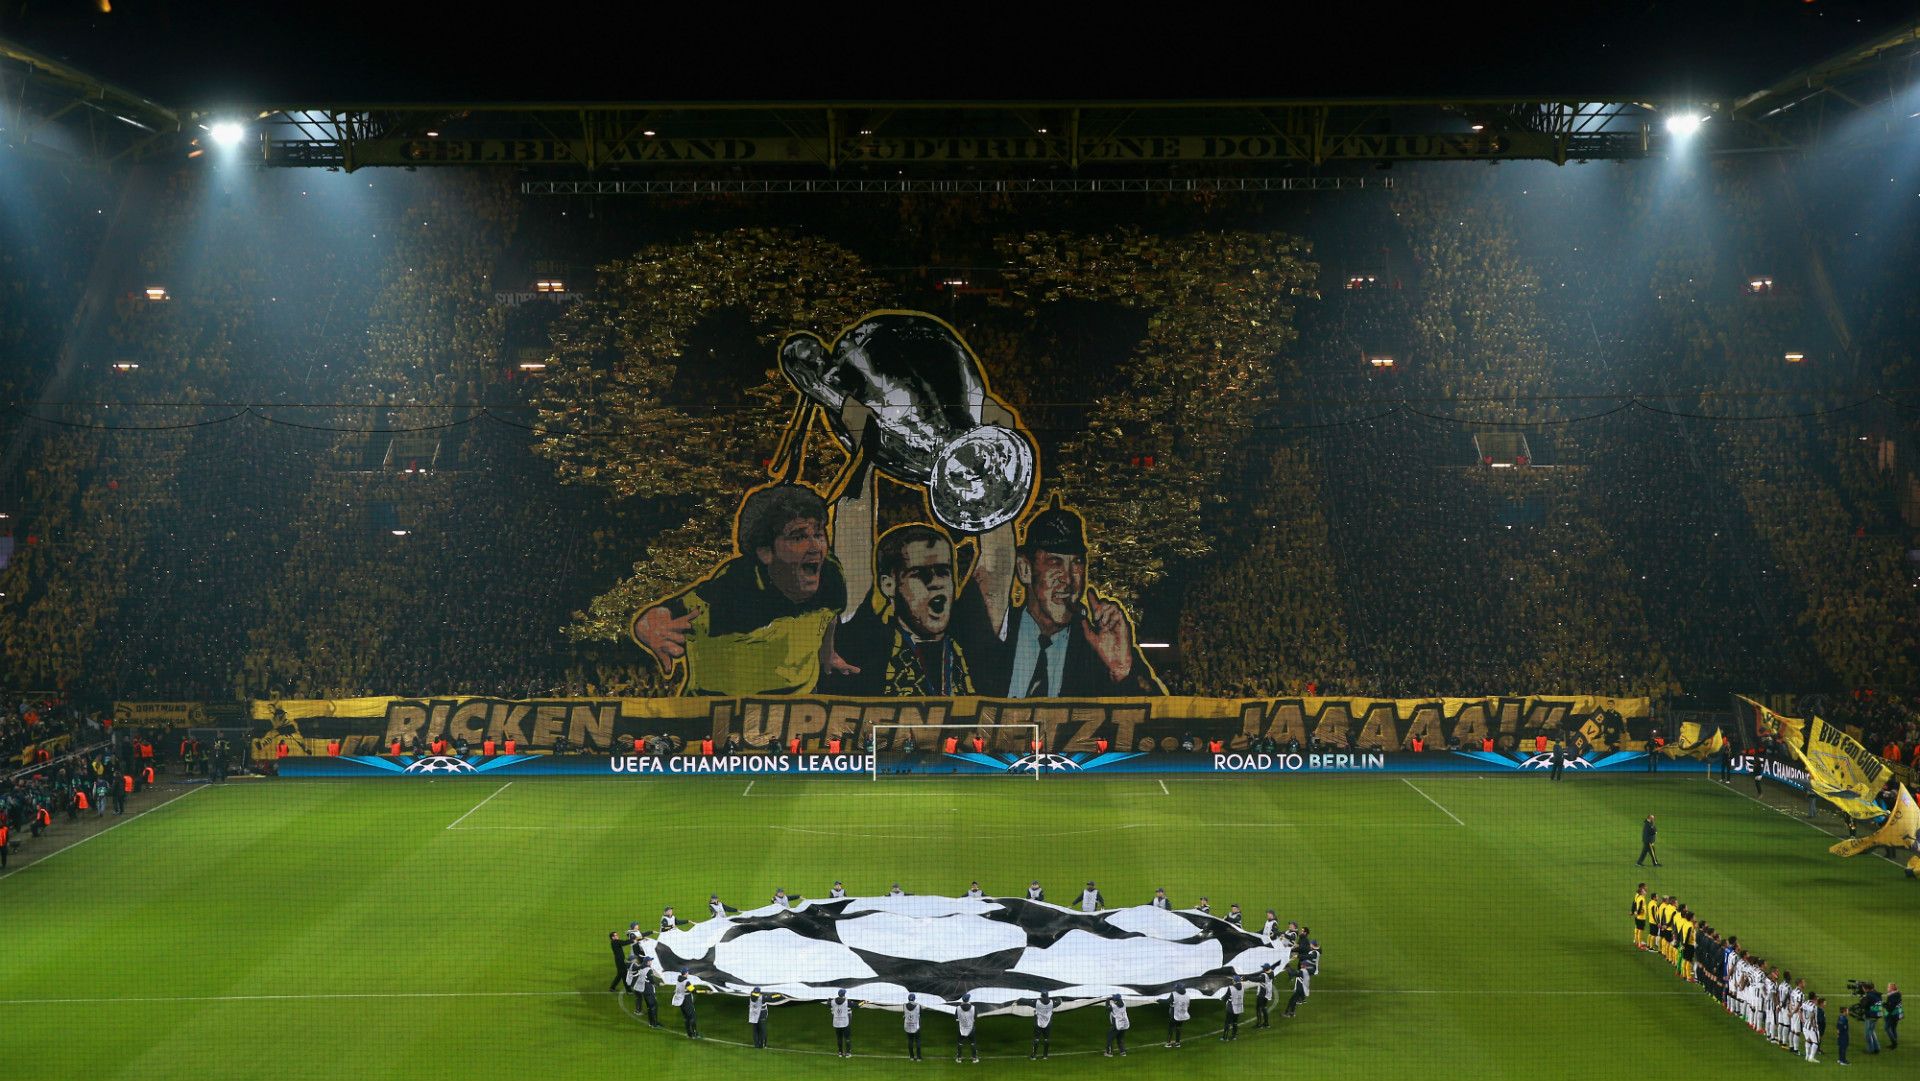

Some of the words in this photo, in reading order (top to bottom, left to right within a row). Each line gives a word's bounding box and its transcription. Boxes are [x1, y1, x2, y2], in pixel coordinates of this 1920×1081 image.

[603, 140, 757, 161] WAND
[1819, 722, 1841, 746] BVB
[610, 756, 664, 773] UEFA
[669, 755, 790, 773] CHAMPIONS
[798, 754, 875, 772] LEAGUE
[1215, 753, 1272, 770] ROAD
[1276, 753, 1304, 770] TO
[1309, 753, 1385, 770] BERLIN
